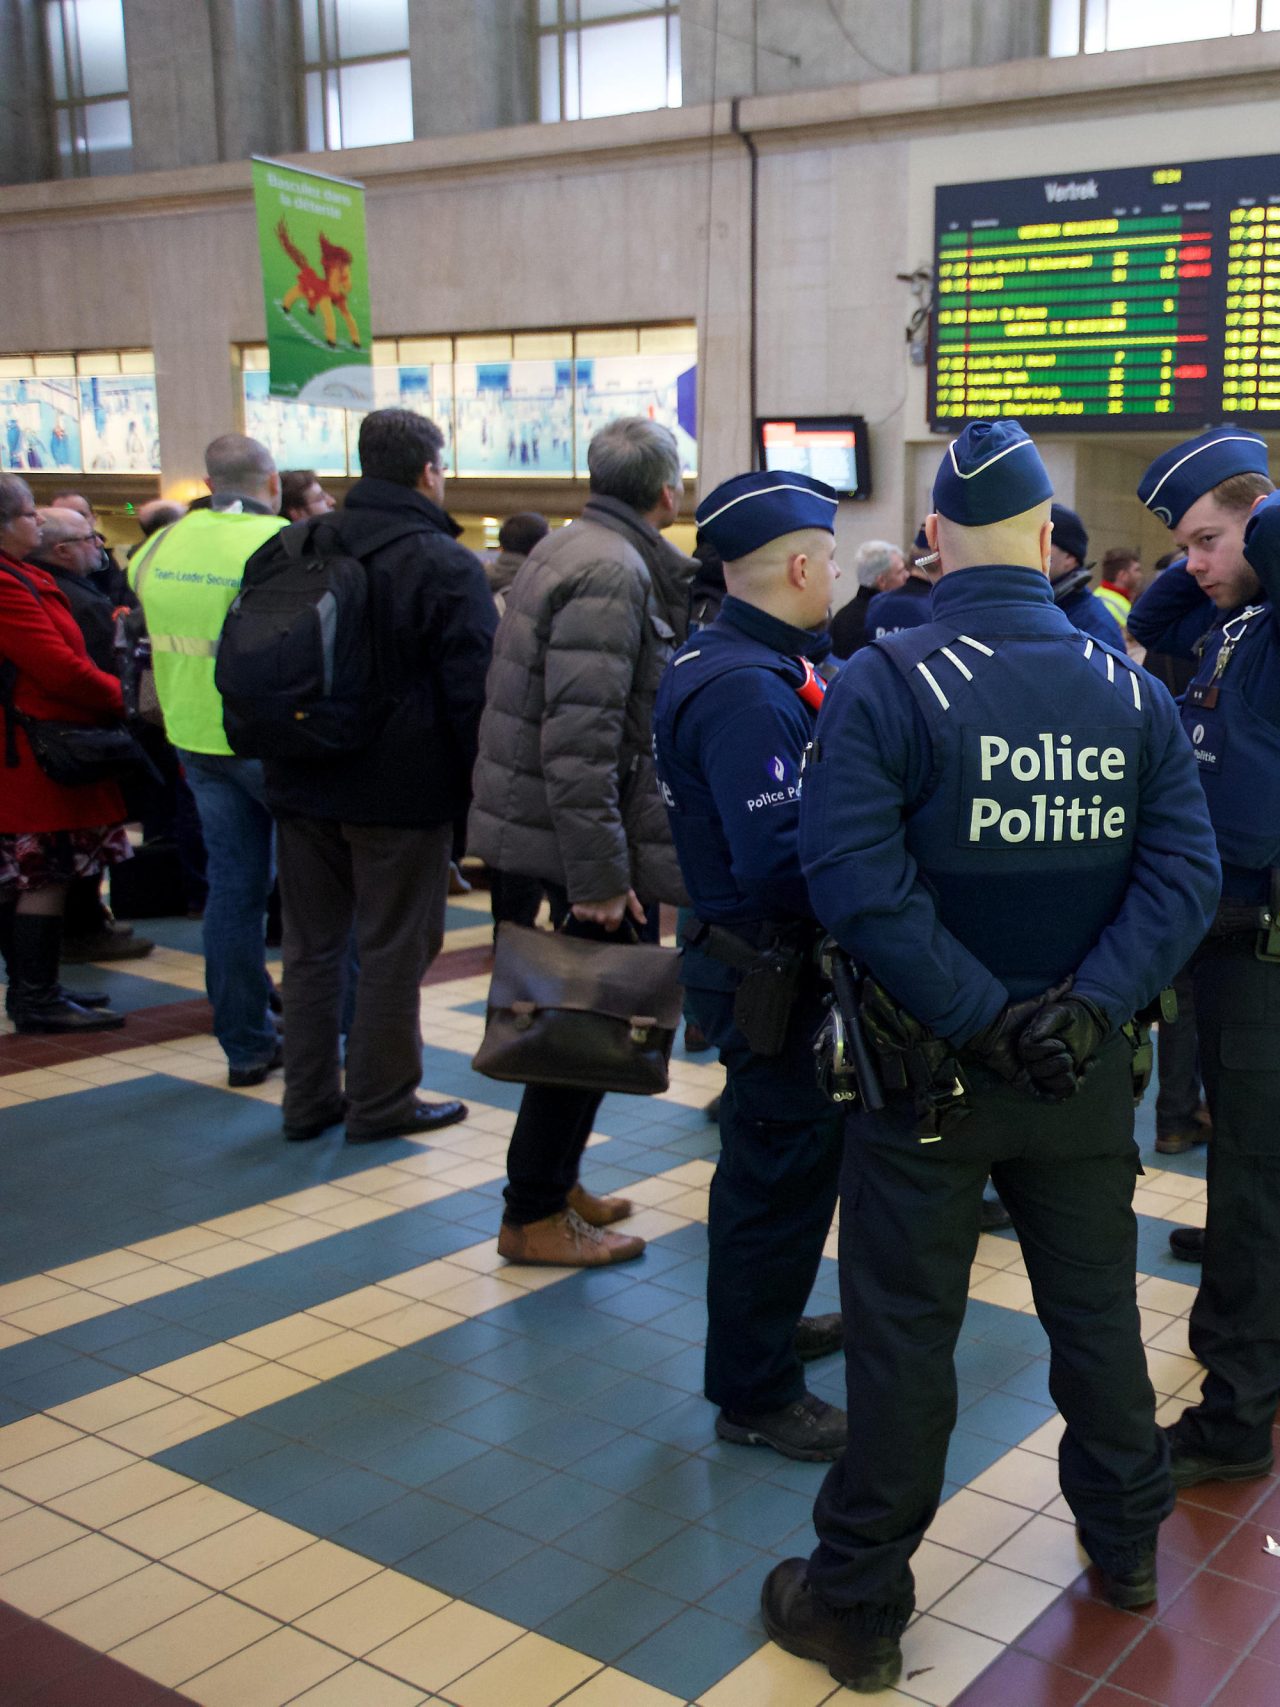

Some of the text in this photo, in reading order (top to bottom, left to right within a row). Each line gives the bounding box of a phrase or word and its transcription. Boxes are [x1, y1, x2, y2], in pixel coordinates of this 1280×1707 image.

[1044, 179, 1099, 203] Vertrek
[980, 733, 1126, 781] Police
[746, 790, 785, 812] Police
[969, 794, 1126, 843] Politie
